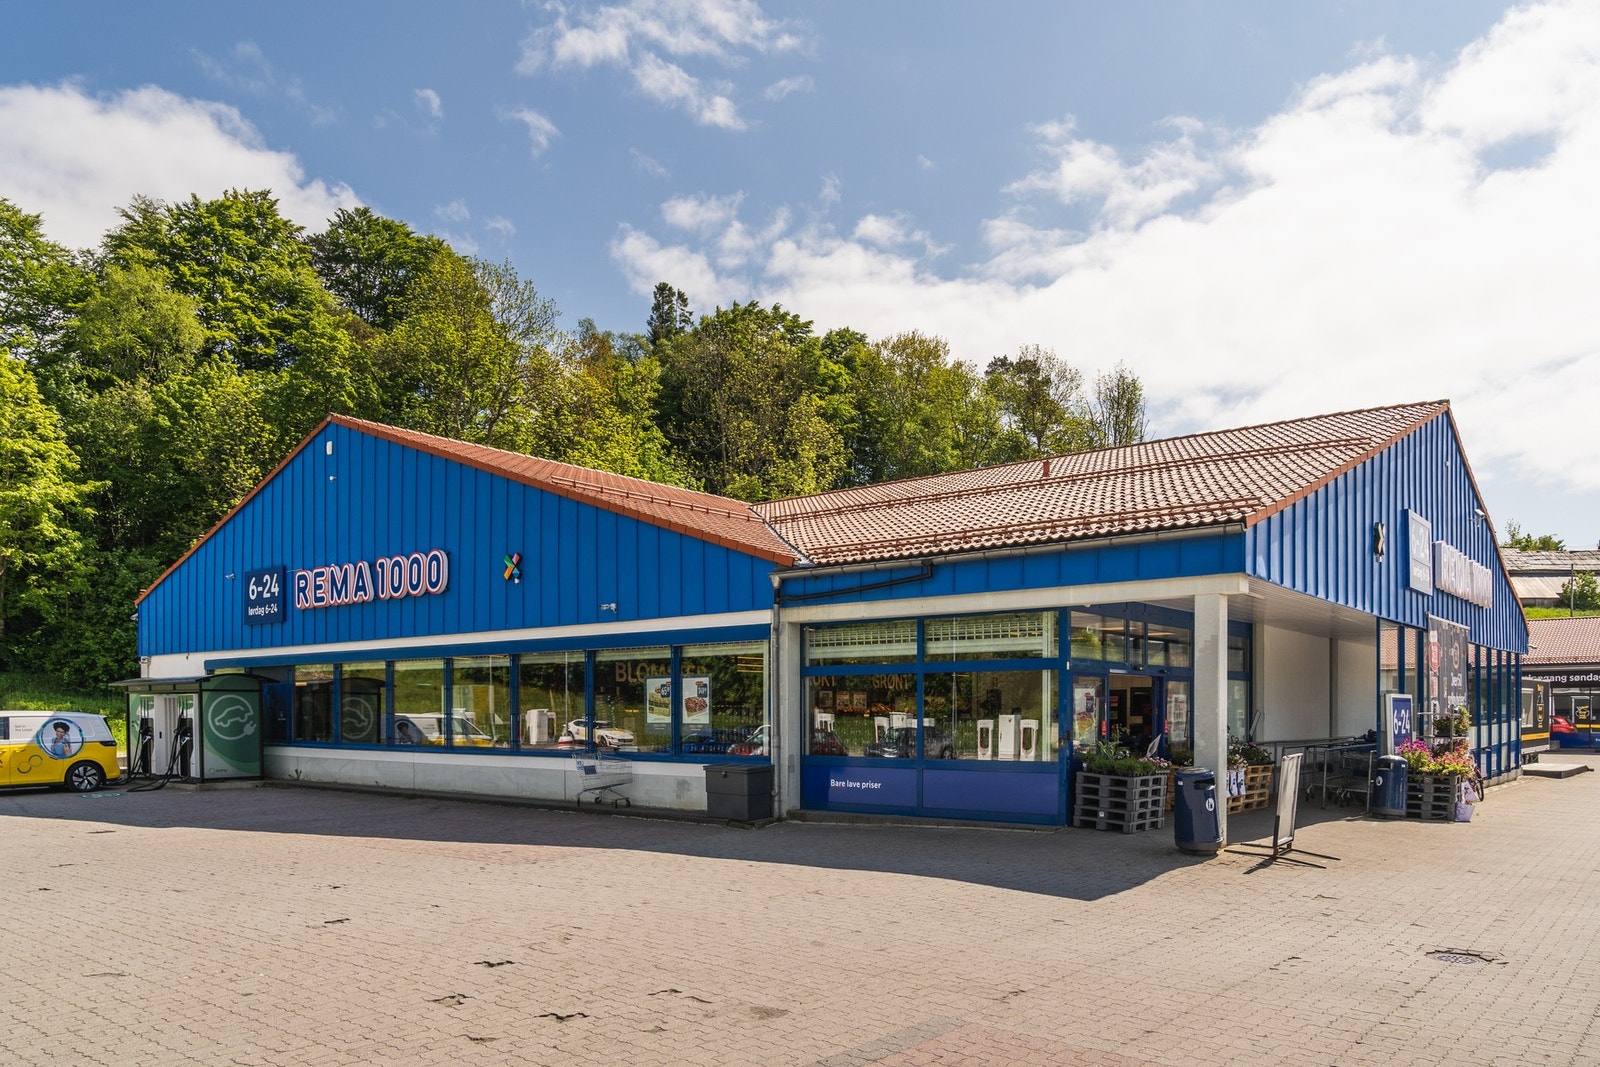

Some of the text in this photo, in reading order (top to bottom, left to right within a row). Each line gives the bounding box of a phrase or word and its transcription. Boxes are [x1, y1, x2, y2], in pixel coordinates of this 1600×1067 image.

[248, 573, 280, 600] 6-24
[295, 549, 448, 610] REMA 1000
[248, 603, 278, 616] lørdag 6-24
[1393, 708, 1411, 735] 6-24
[830, 779, 882, 790] Bare lave priser
